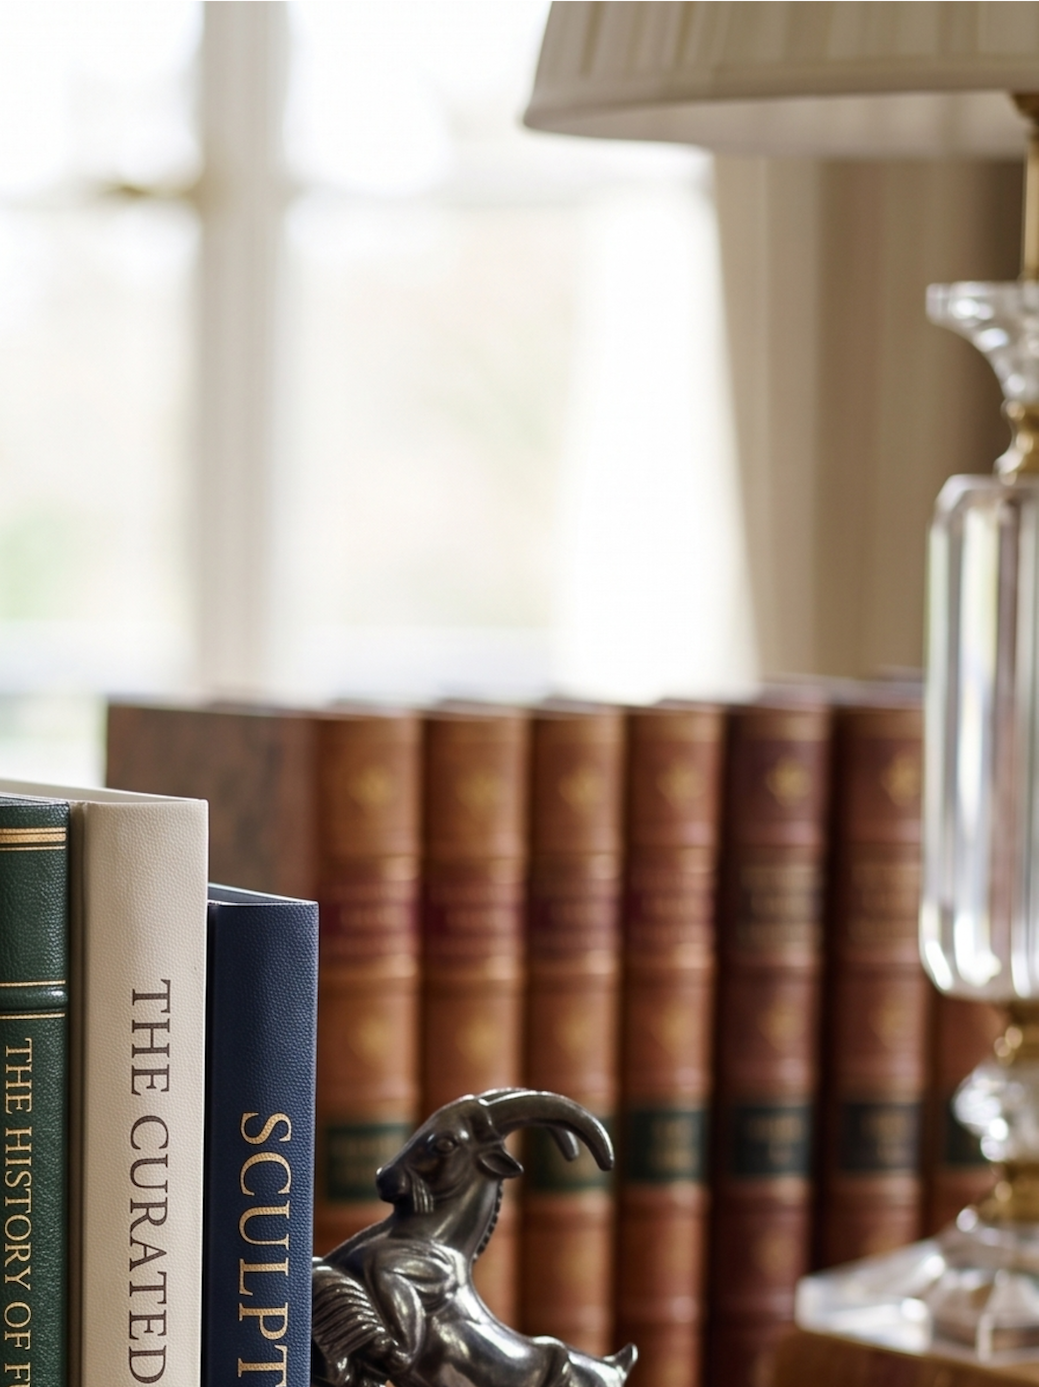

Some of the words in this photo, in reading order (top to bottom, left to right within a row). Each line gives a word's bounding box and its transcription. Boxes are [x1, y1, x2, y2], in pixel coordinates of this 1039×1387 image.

[5, 1037, 32, 1115] THE
[131, 978, 171, 1096] THE
[4, 1126, 32, 1290] HISTORY
[129, 1115, 169, 1384] CURATED
[3, 1301, 32, 1350] OF
